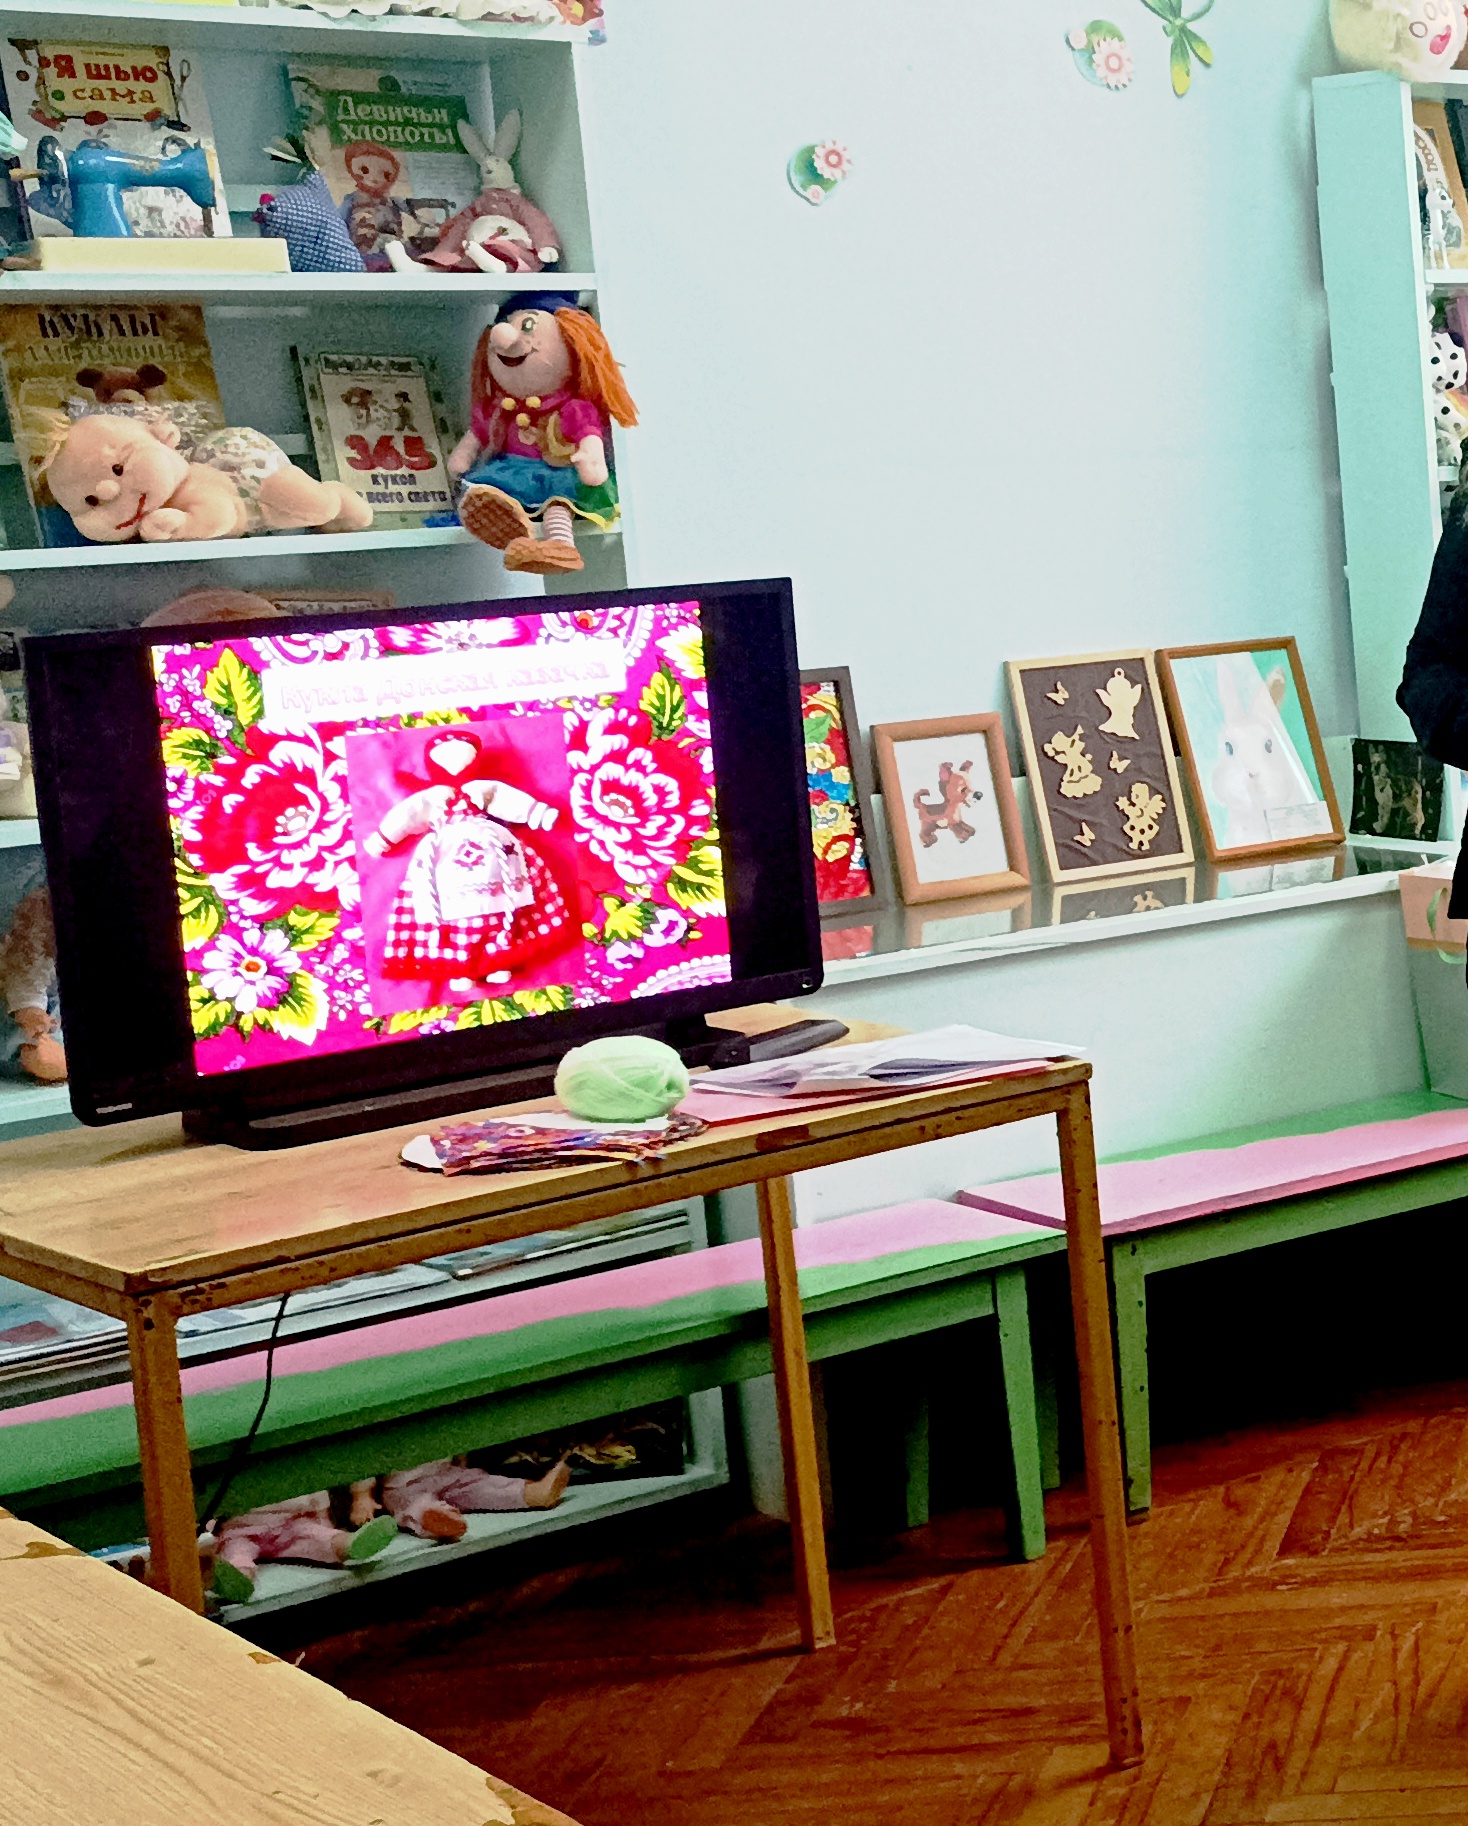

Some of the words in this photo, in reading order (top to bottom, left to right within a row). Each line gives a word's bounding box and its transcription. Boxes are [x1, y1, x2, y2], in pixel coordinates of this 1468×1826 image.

[53, 54, 78, 79] Я
[83, 62, 159, 84] шью
[72, 87, 155, 105] сама
[336, 95, 448, 123] Девичьи
[339, 123, 456, 145] хлопоты
[345, 434, 438, 471] 365
